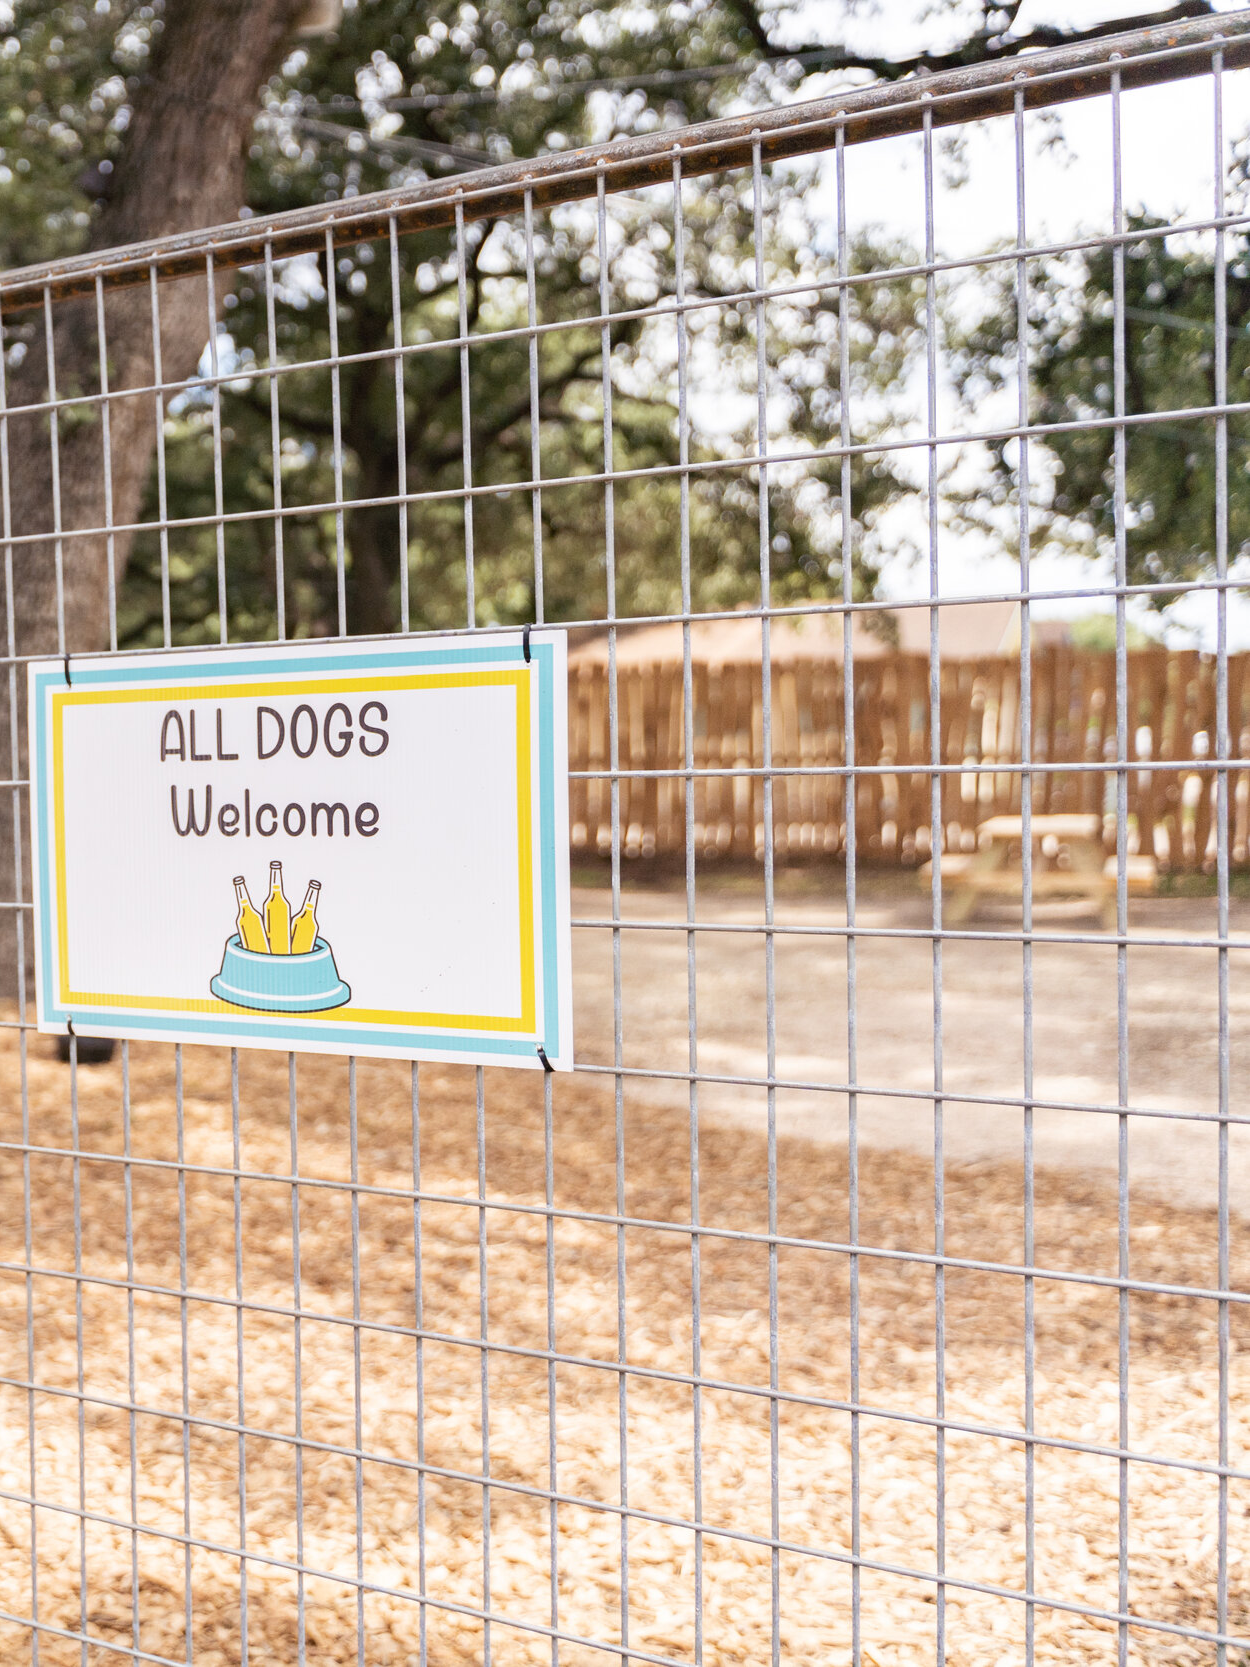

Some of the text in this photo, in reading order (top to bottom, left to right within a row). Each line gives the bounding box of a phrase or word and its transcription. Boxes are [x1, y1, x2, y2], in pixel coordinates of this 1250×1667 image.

[161, 701, 390, 762] ALL DOGS
[170, 784, 380, 838] Welcome
